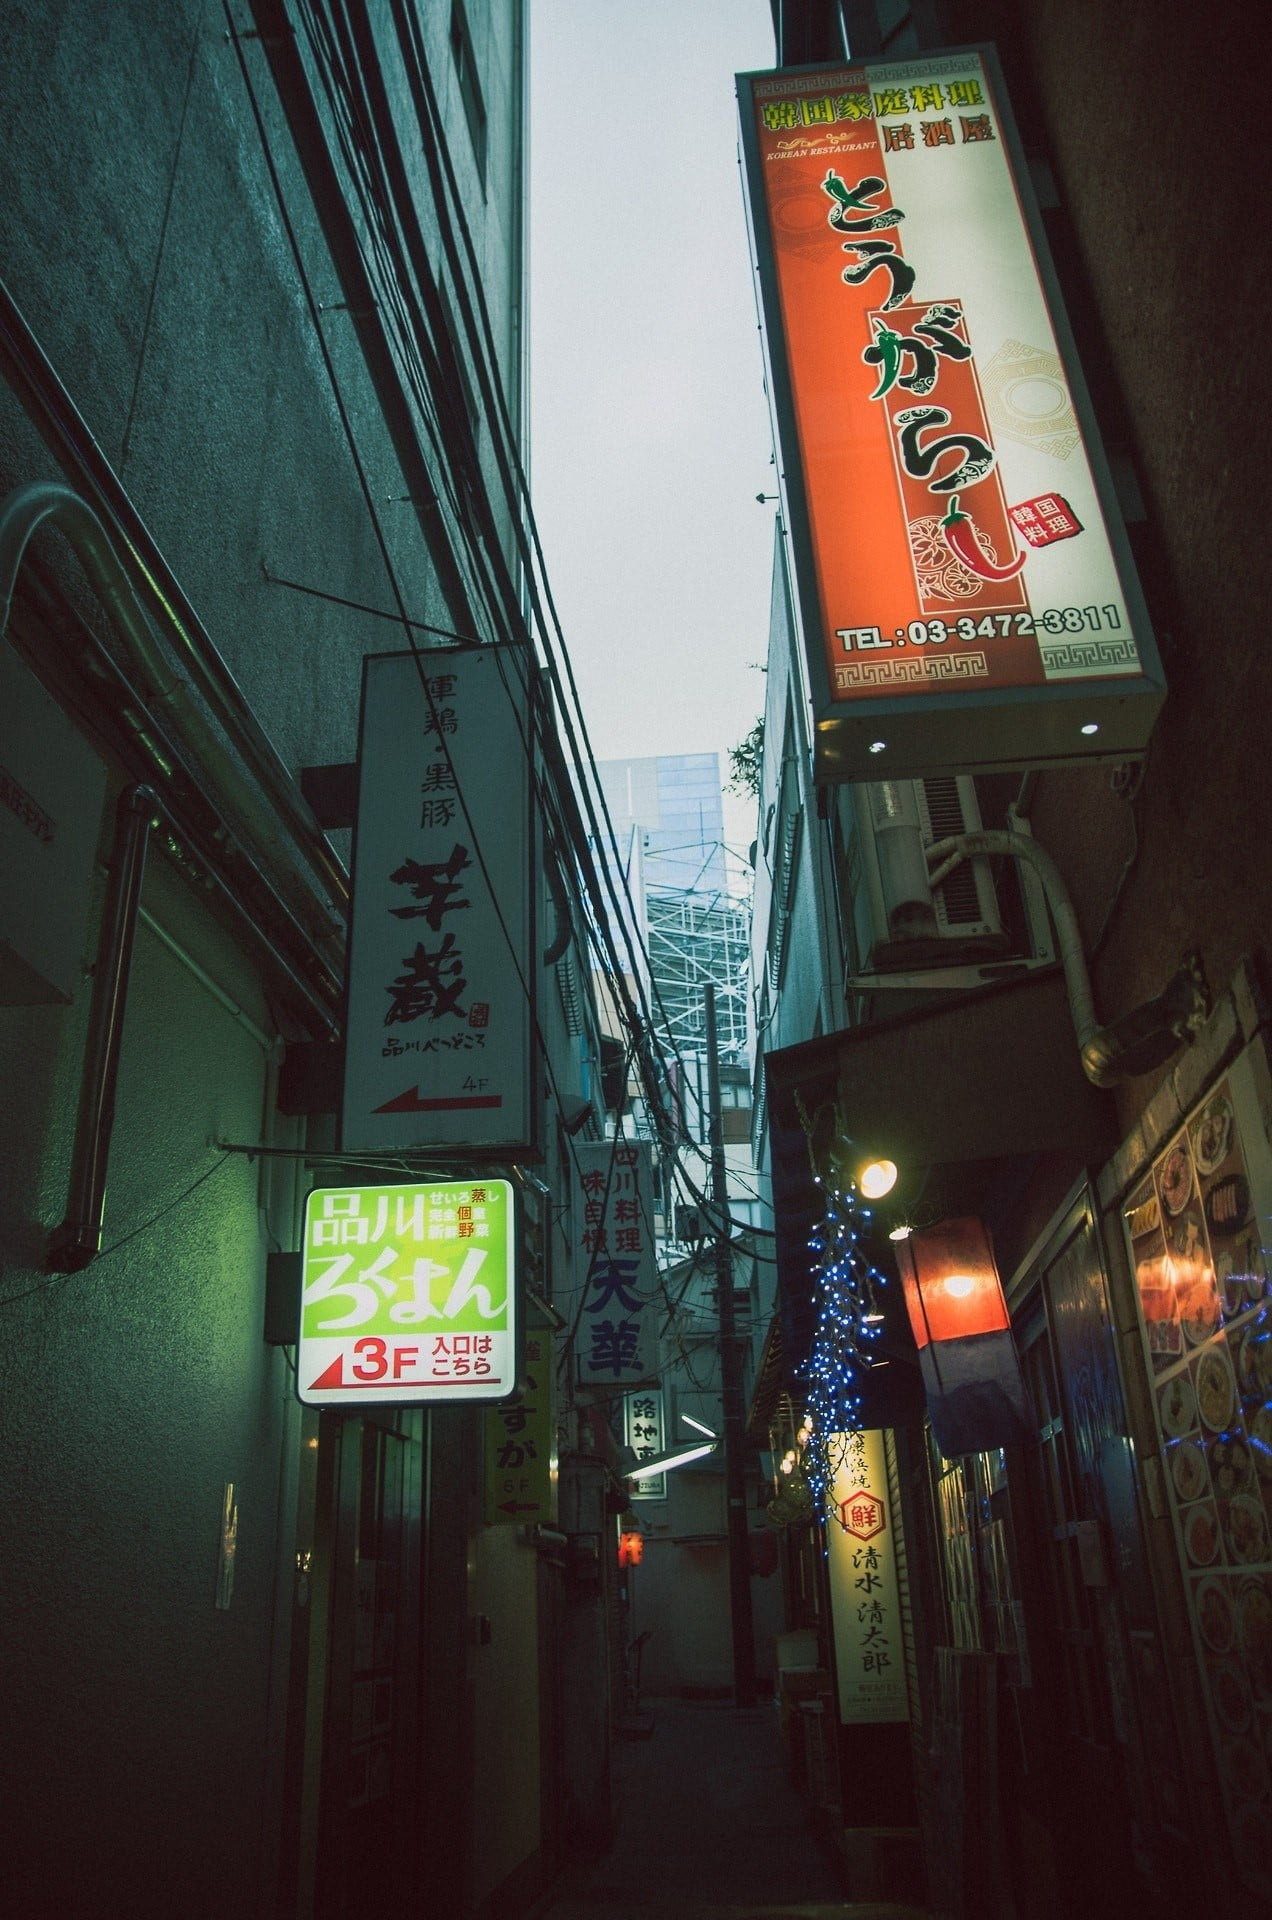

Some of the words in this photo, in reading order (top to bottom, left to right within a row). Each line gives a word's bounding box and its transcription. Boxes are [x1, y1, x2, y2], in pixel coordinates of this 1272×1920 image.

[763, 79, 986, 130] 韓国家庭料理
[767, 149, 807, 160] KOREAN
[809, 141, 878, 156] RESTAURANT
[882, 113, 997, 152] 居酒屋
[463, 1075, 490, 1092] 4F
[312, 1193, 426, 1247] 品川
[613, 1147, 644, 1253] 四川料理
[303, 1246, 510, 1330] ろくよん
[583, 1259, 646, 1377] 天華
[352, 1337, 419, 1381] 3F
[431, 1336, 493, 1355] 入口は
[432, 1358, 492, 1376] こちら
